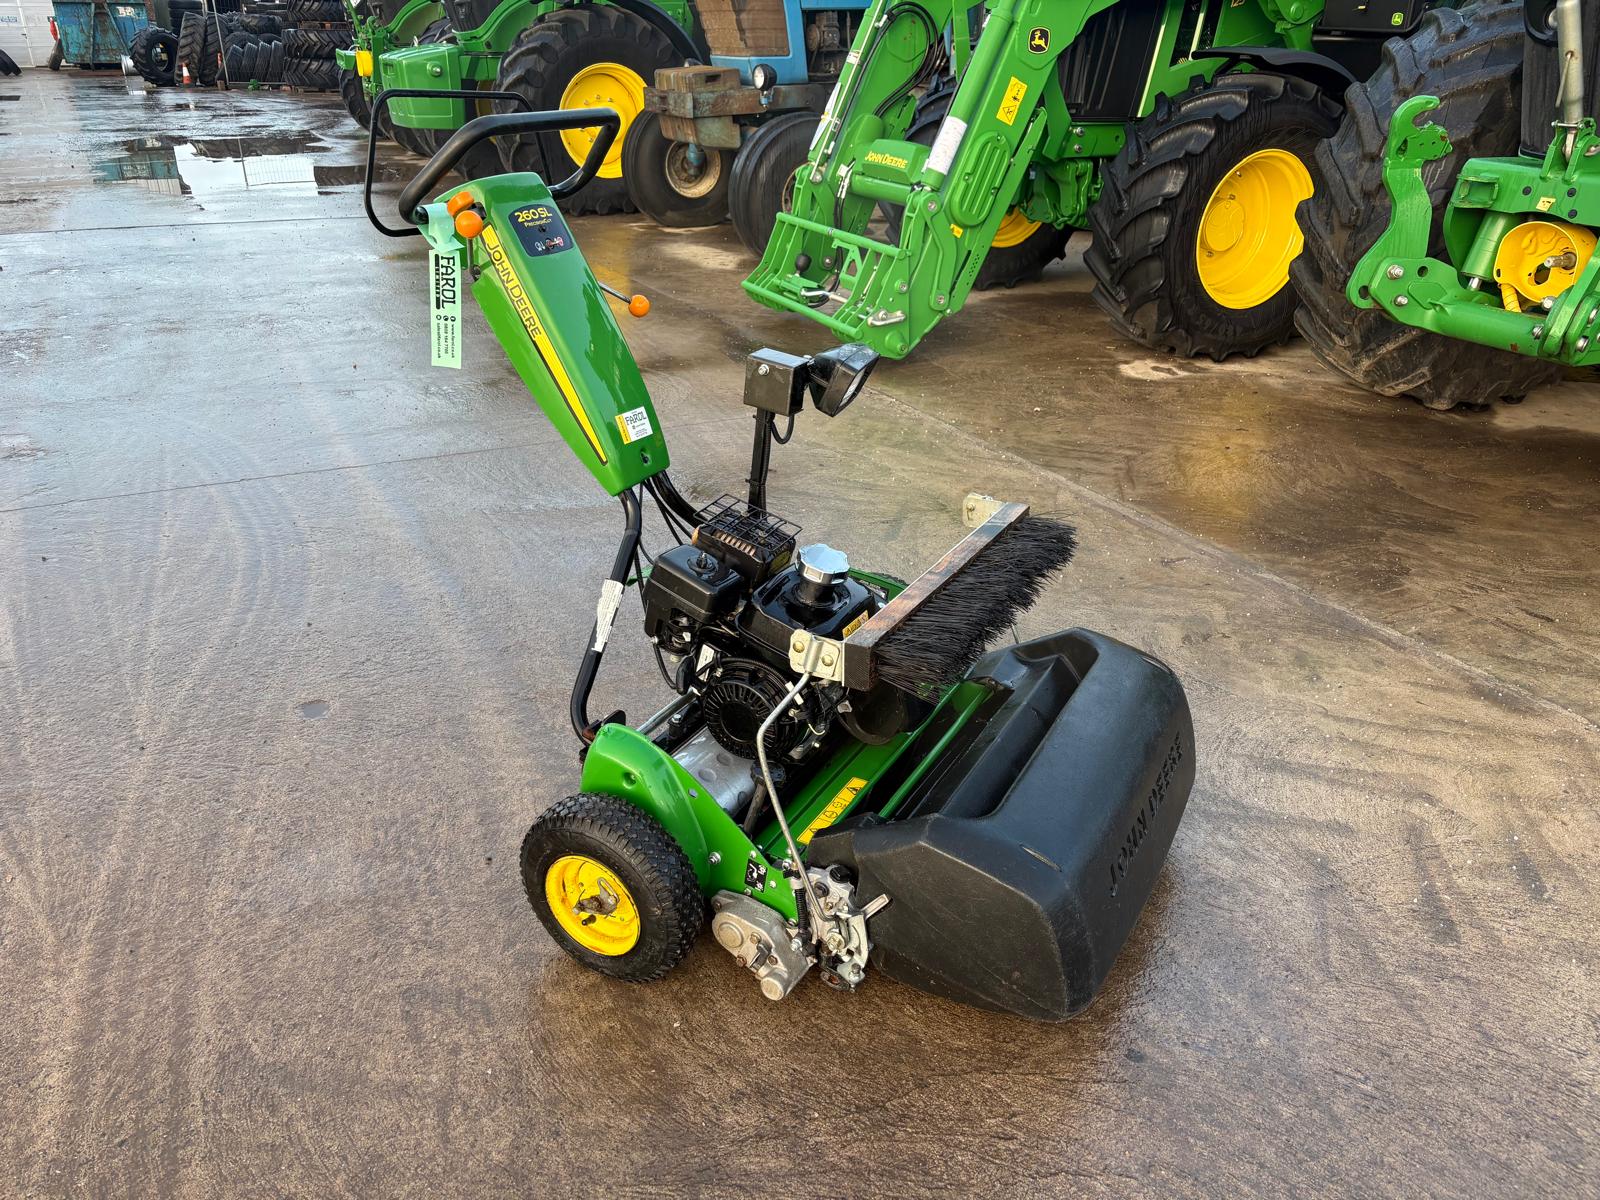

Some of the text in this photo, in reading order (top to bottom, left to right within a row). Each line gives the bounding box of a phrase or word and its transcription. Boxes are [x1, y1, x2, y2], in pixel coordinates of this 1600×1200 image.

[865, 151, 908, 168] JOHN DEERE
[441, 255, 456, 309] FAROL
[487, 242, 542, 338] JOHN DEERE
[624, 411, 647, 425] FAROL
[1109, 730, 1183, 898] JOHN DEERE
